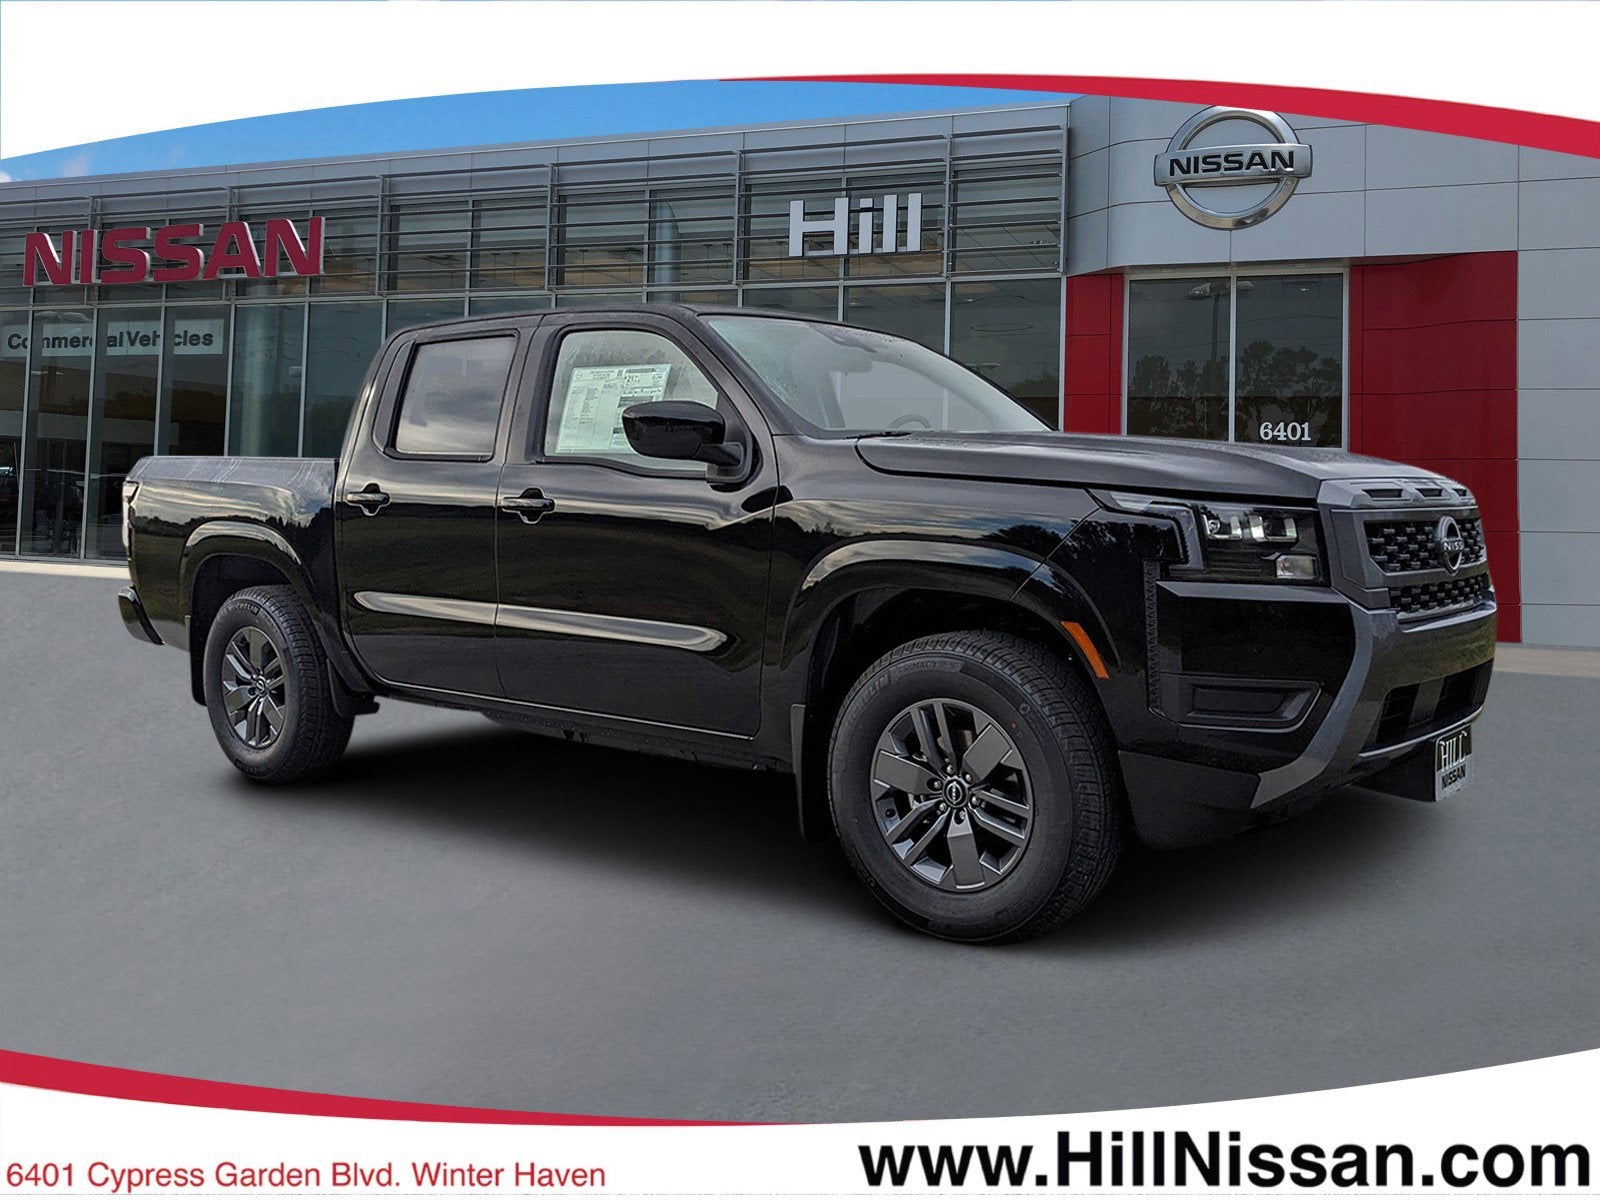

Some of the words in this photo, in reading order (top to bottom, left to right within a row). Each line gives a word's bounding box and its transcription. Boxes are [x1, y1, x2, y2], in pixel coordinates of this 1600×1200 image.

[1169, 150, 1295, 177] NISSAN
[788, 192, 922, 257] Hill
[22, 216, 326, 287] NISSAN
[7, 331, 124, 350] Commeral
[126, 330, 214, 348] Vehcles
[1259, 421, 1312, 441] 6401
[1443, 541, 1465, 551] NISS
[1439, 730, 1468, 773] HILL
[1441, 763, 1467, 791] NISSAN
